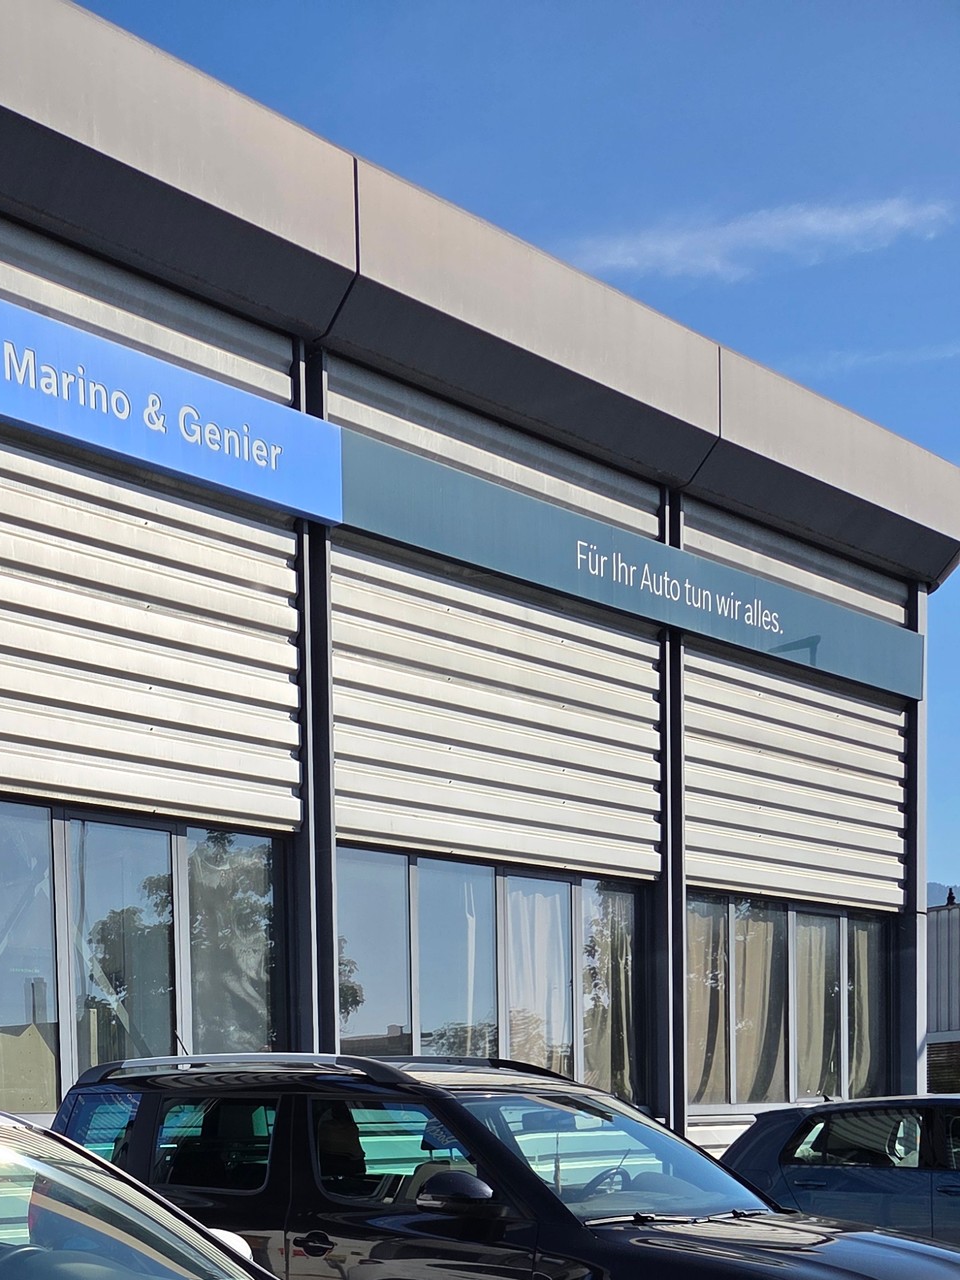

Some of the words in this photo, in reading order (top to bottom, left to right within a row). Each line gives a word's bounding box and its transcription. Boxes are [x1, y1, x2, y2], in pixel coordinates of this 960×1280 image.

[3, 340, 131, 420] Marino
[143, 392, 167, 434] &
[178, 404, 283, 470] Genier
[576, 540, 607, 577] Für
[612, 552, 637, 587] Ihr
[640, 563, 680, 601] Auto
[685, 577, 711, 612] tun
[716, 592, 741, 620] wir
[744, 599, 784, 634] alles.
